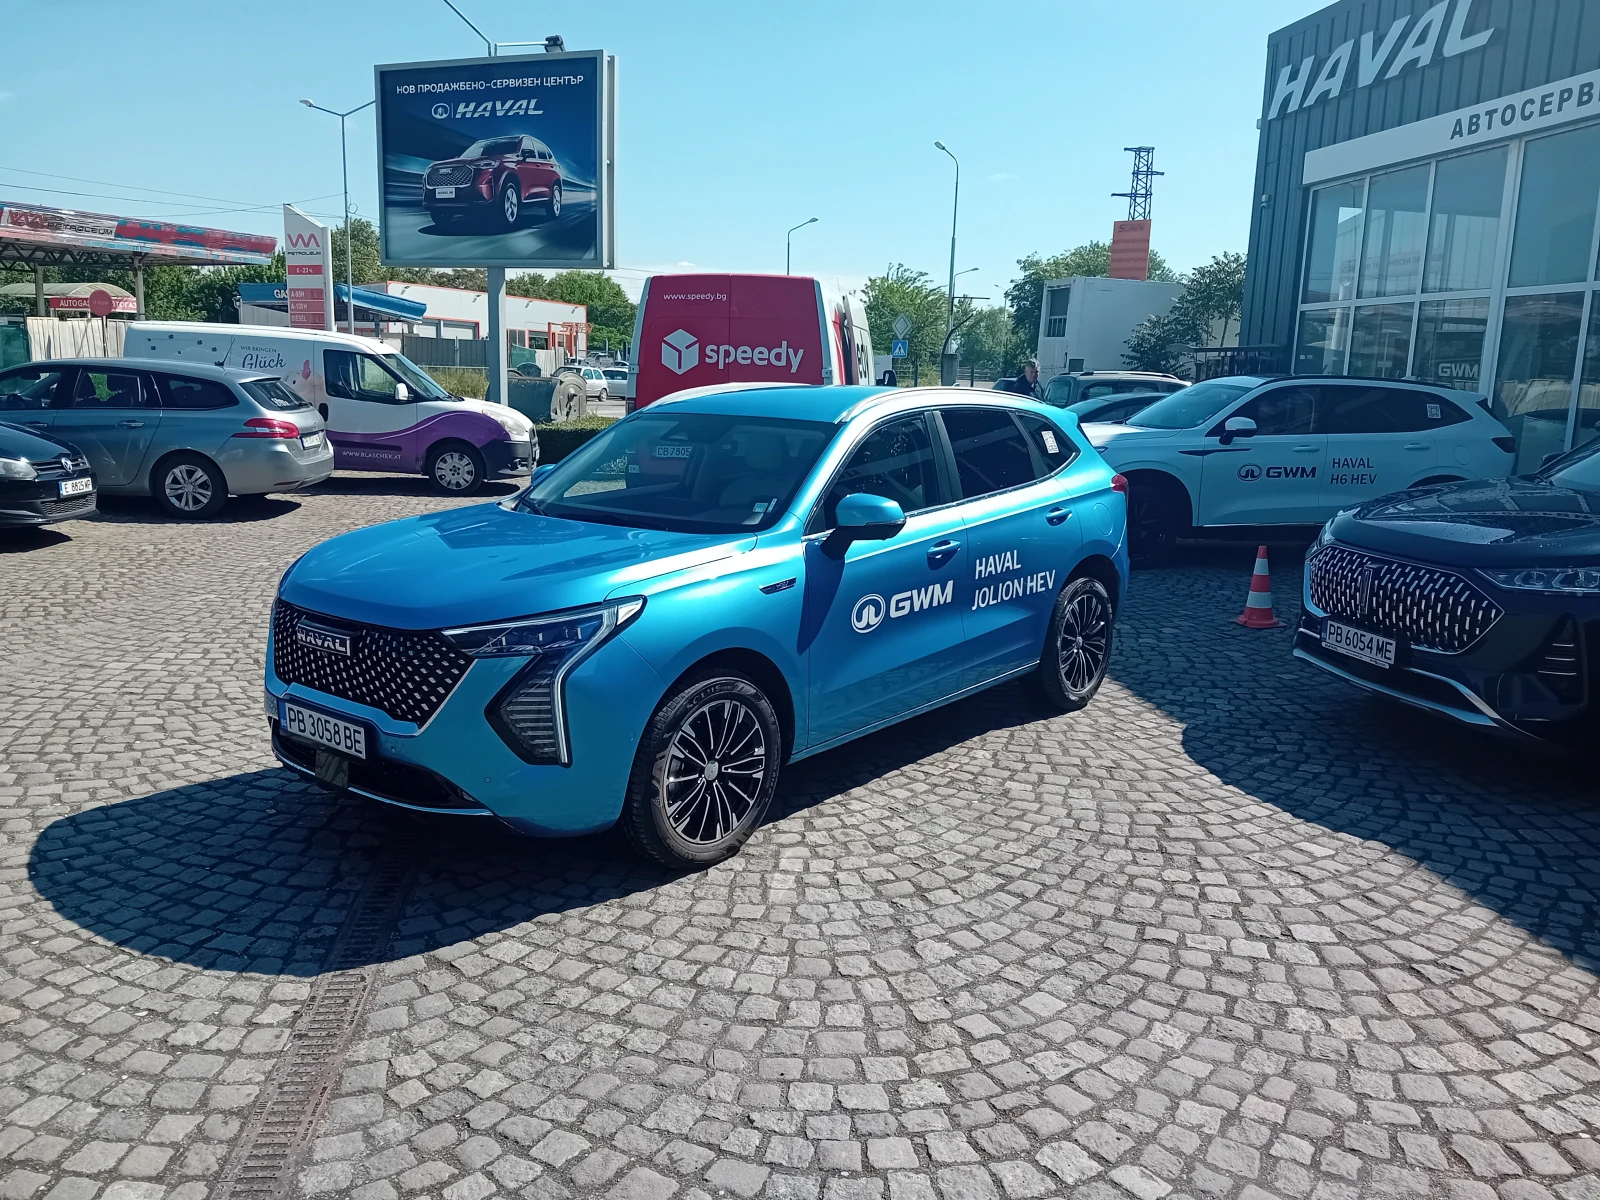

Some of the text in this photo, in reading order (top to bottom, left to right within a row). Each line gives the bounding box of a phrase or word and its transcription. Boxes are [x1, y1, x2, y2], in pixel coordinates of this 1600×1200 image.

[1268, 0, 1496, 120] HAVAL
[396, 75, 584, 95] НОВ ПРОДАЖБЕНО-СЕРВИЗЕН ЦЕНТЪР
[455, 98, 544, 119] HAVAL
[1449, 82, 1600, 140] АВТОСЕРВ
[47, 222, 113, 235] PETROLEUM
[663, 292, 727, 301] www.speedy.bg
[241, 352, 287, 370] Glück
[704, 340, 805, 373] speedy
[1438, 363, 1479, 378] GWM
[341, 450, 402, 460] WWW.BLASCHEK.AT
[670, 447, 691, 457] 7805
[1265, 466, 1317, 479] GWM
[1332, 457, 1374, 469] HAVAL
[1330, 473, 1378, 485] H6 HEV
[974, 549, 1022, 580] HAVAL
[889, 580, 954, 619] GWM
[971, 569, 1056, 611] JOLION HEV
[297, 628, 346, 652] HAVAL
[1328, 623, 1393, 661] PB 6054 ME
[287, 706, 363, 755] PB 3058 BE
